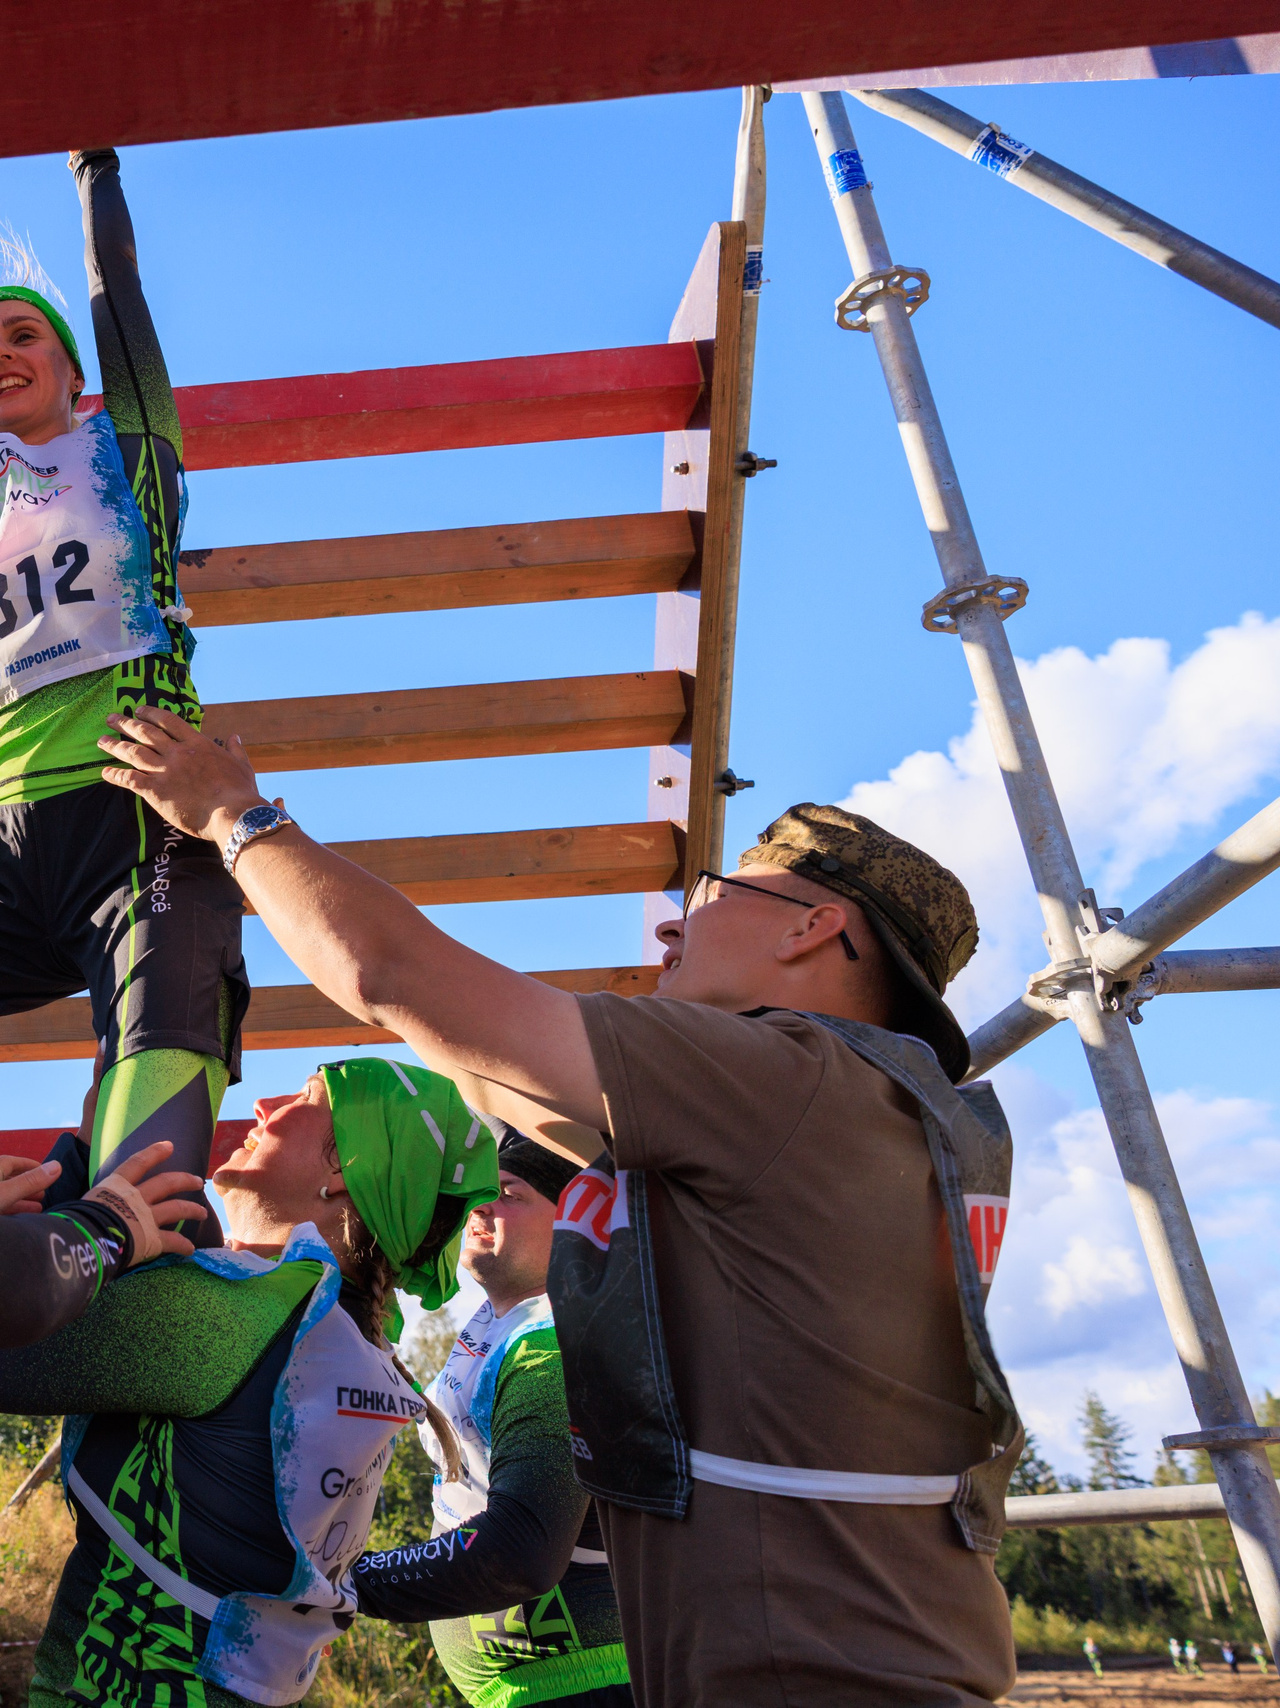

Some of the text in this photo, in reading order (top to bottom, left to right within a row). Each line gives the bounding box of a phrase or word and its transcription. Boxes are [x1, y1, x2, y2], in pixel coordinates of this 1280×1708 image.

[5, 638, 82, 678] ГАЗПРОМБАНК
[337, 1386, 397, 1414] ГОНКА
[355, 1531, 456, 1574] eenway
[370, 1568, 434, 1587] GLOBAL
